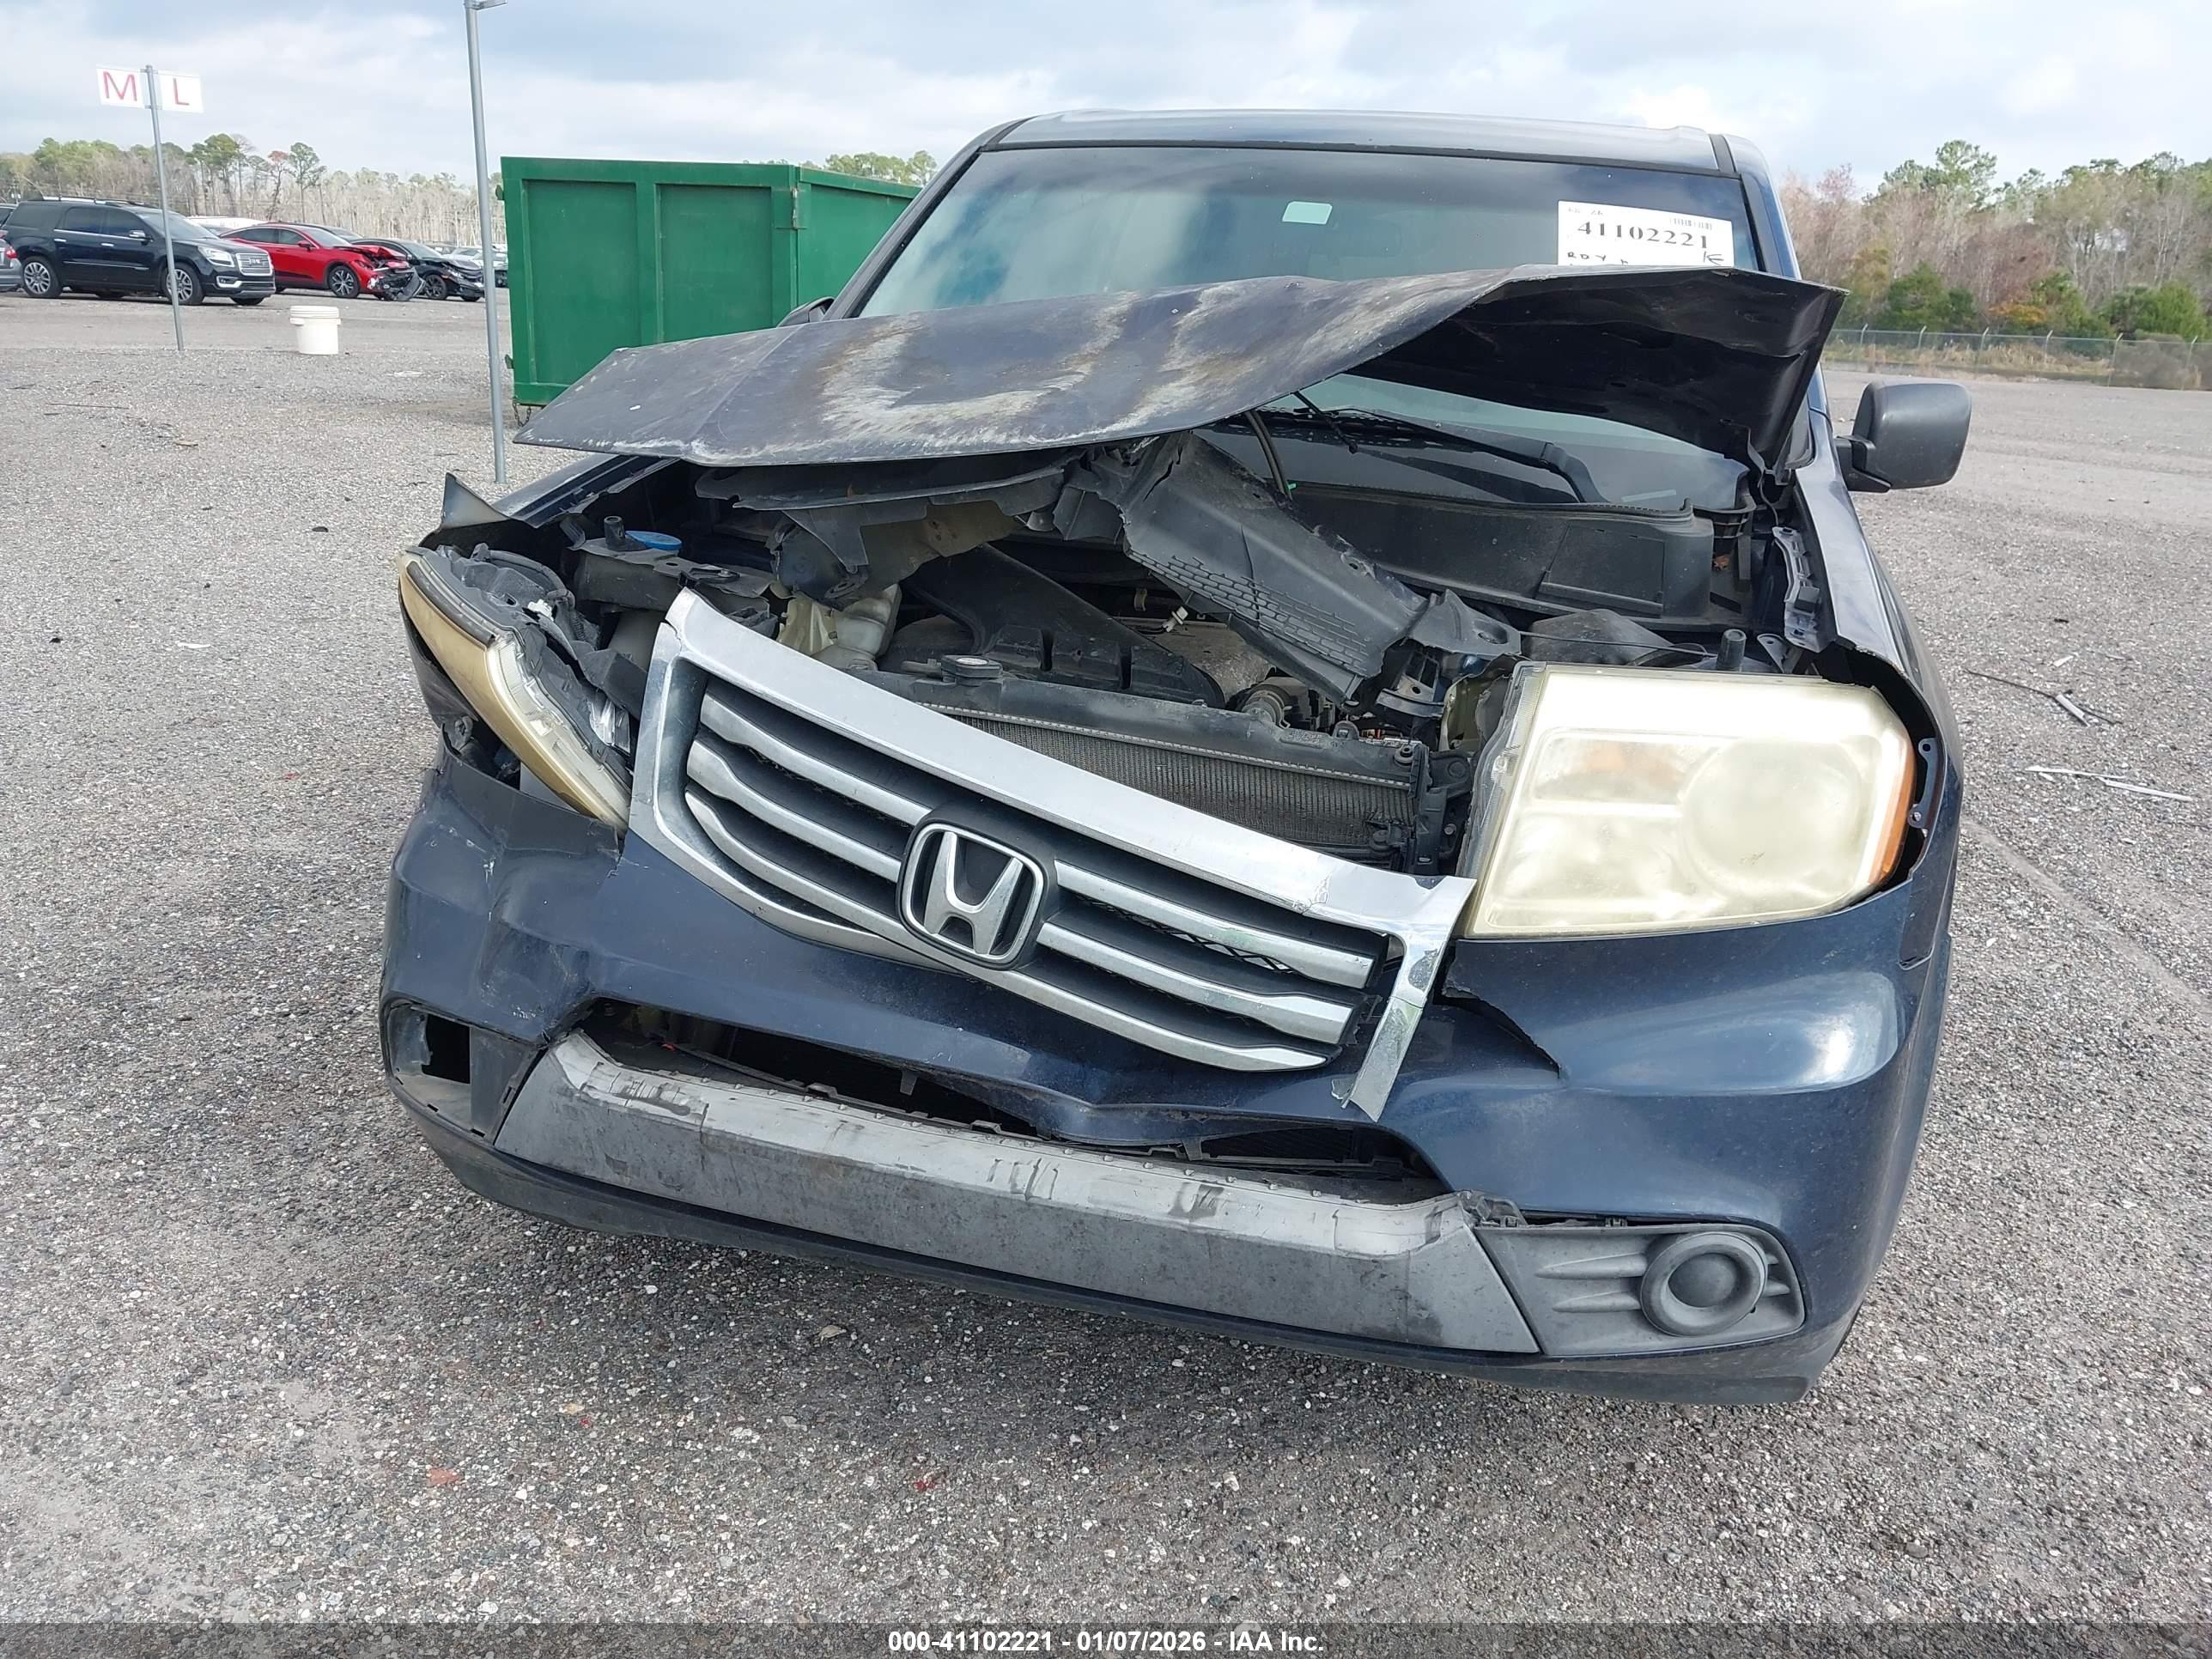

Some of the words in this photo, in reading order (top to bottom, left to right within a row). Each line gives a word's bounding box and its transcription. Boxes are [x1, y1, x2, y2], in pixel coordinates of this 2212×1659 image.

[102, 70, 137, 101] M
[173, 77, 190, 106] L
[1577, 221, 1708, 249] 41102221
